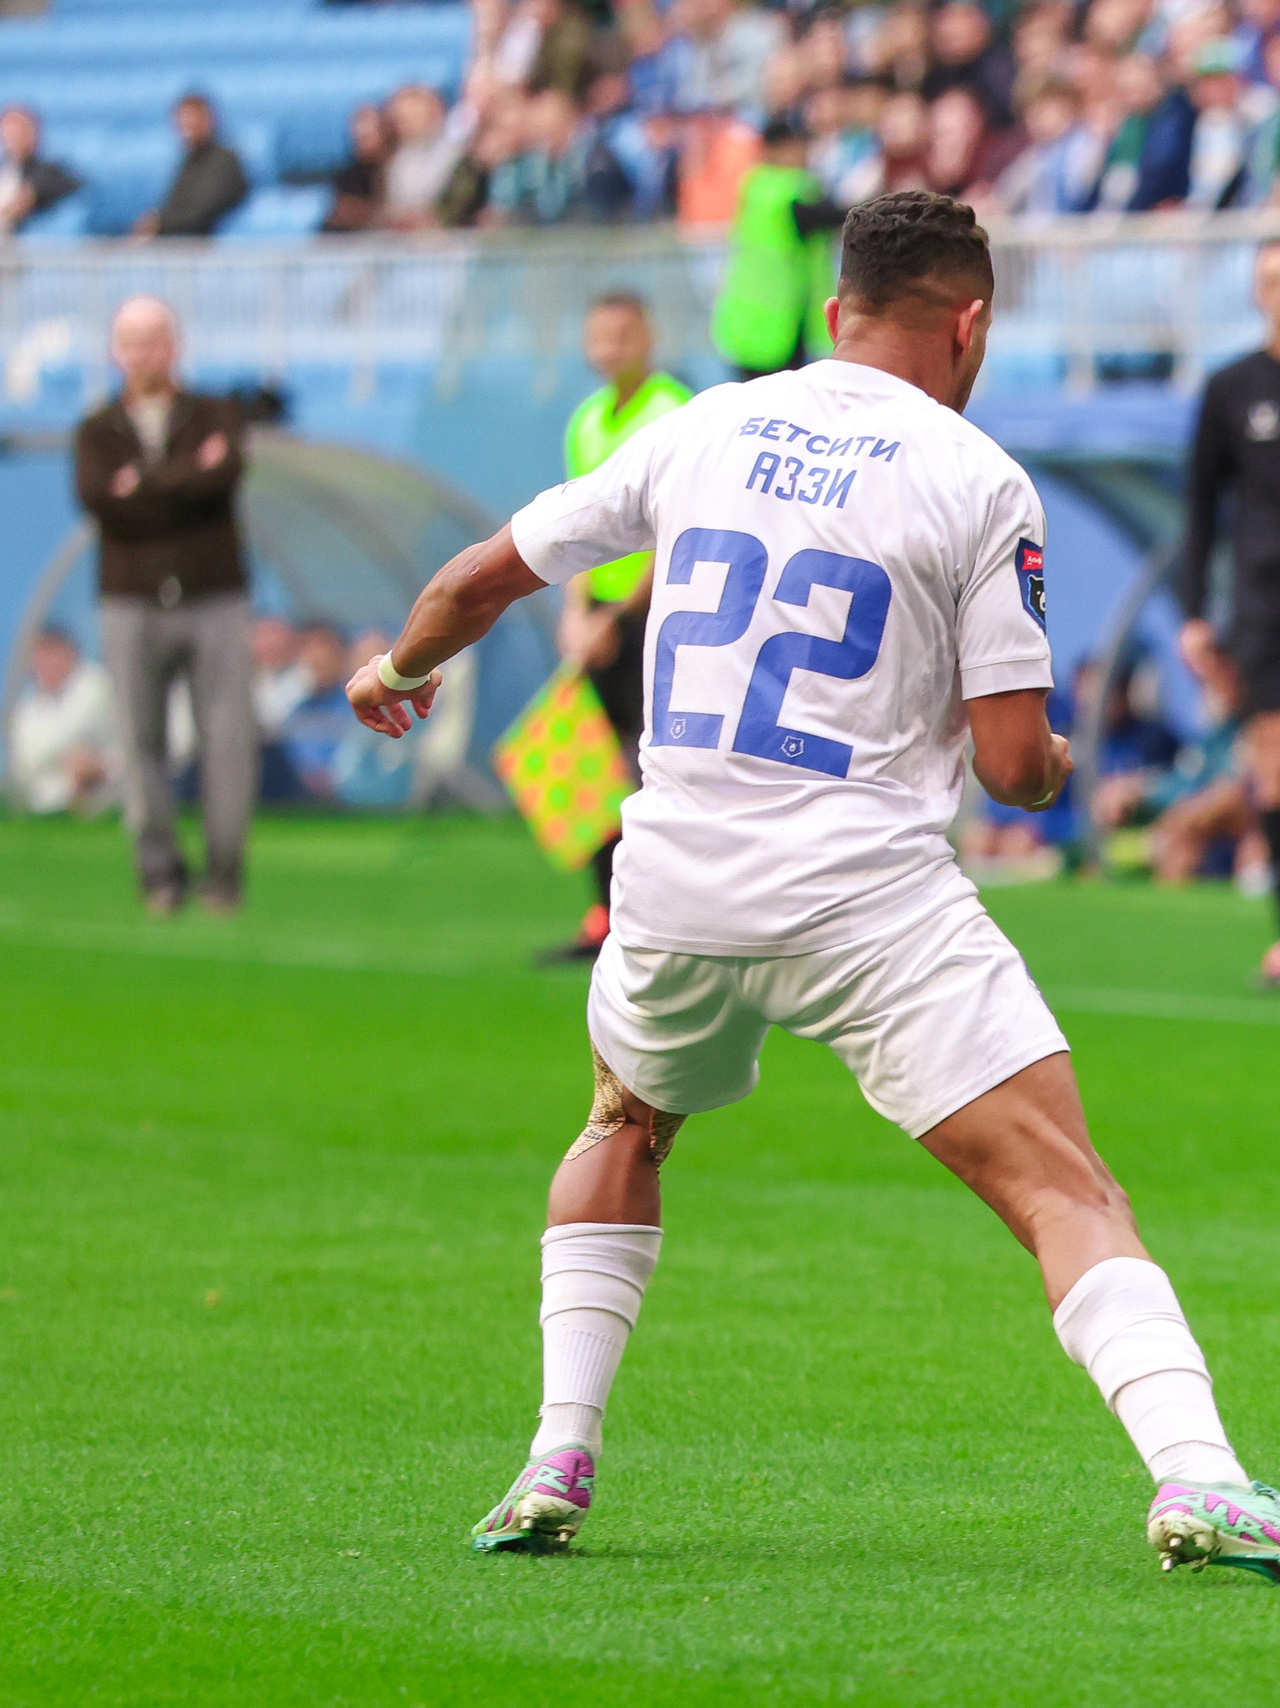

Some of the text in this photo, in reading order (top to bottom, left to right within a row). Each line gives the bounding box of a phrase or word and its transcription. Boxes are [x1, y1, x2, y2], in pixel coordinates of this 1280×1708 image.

[739, 417, 901, 462] БЕТСИТИ
[745, 451, 857, 509] АЗЗИ
[648, 527, 892, 779] 22
